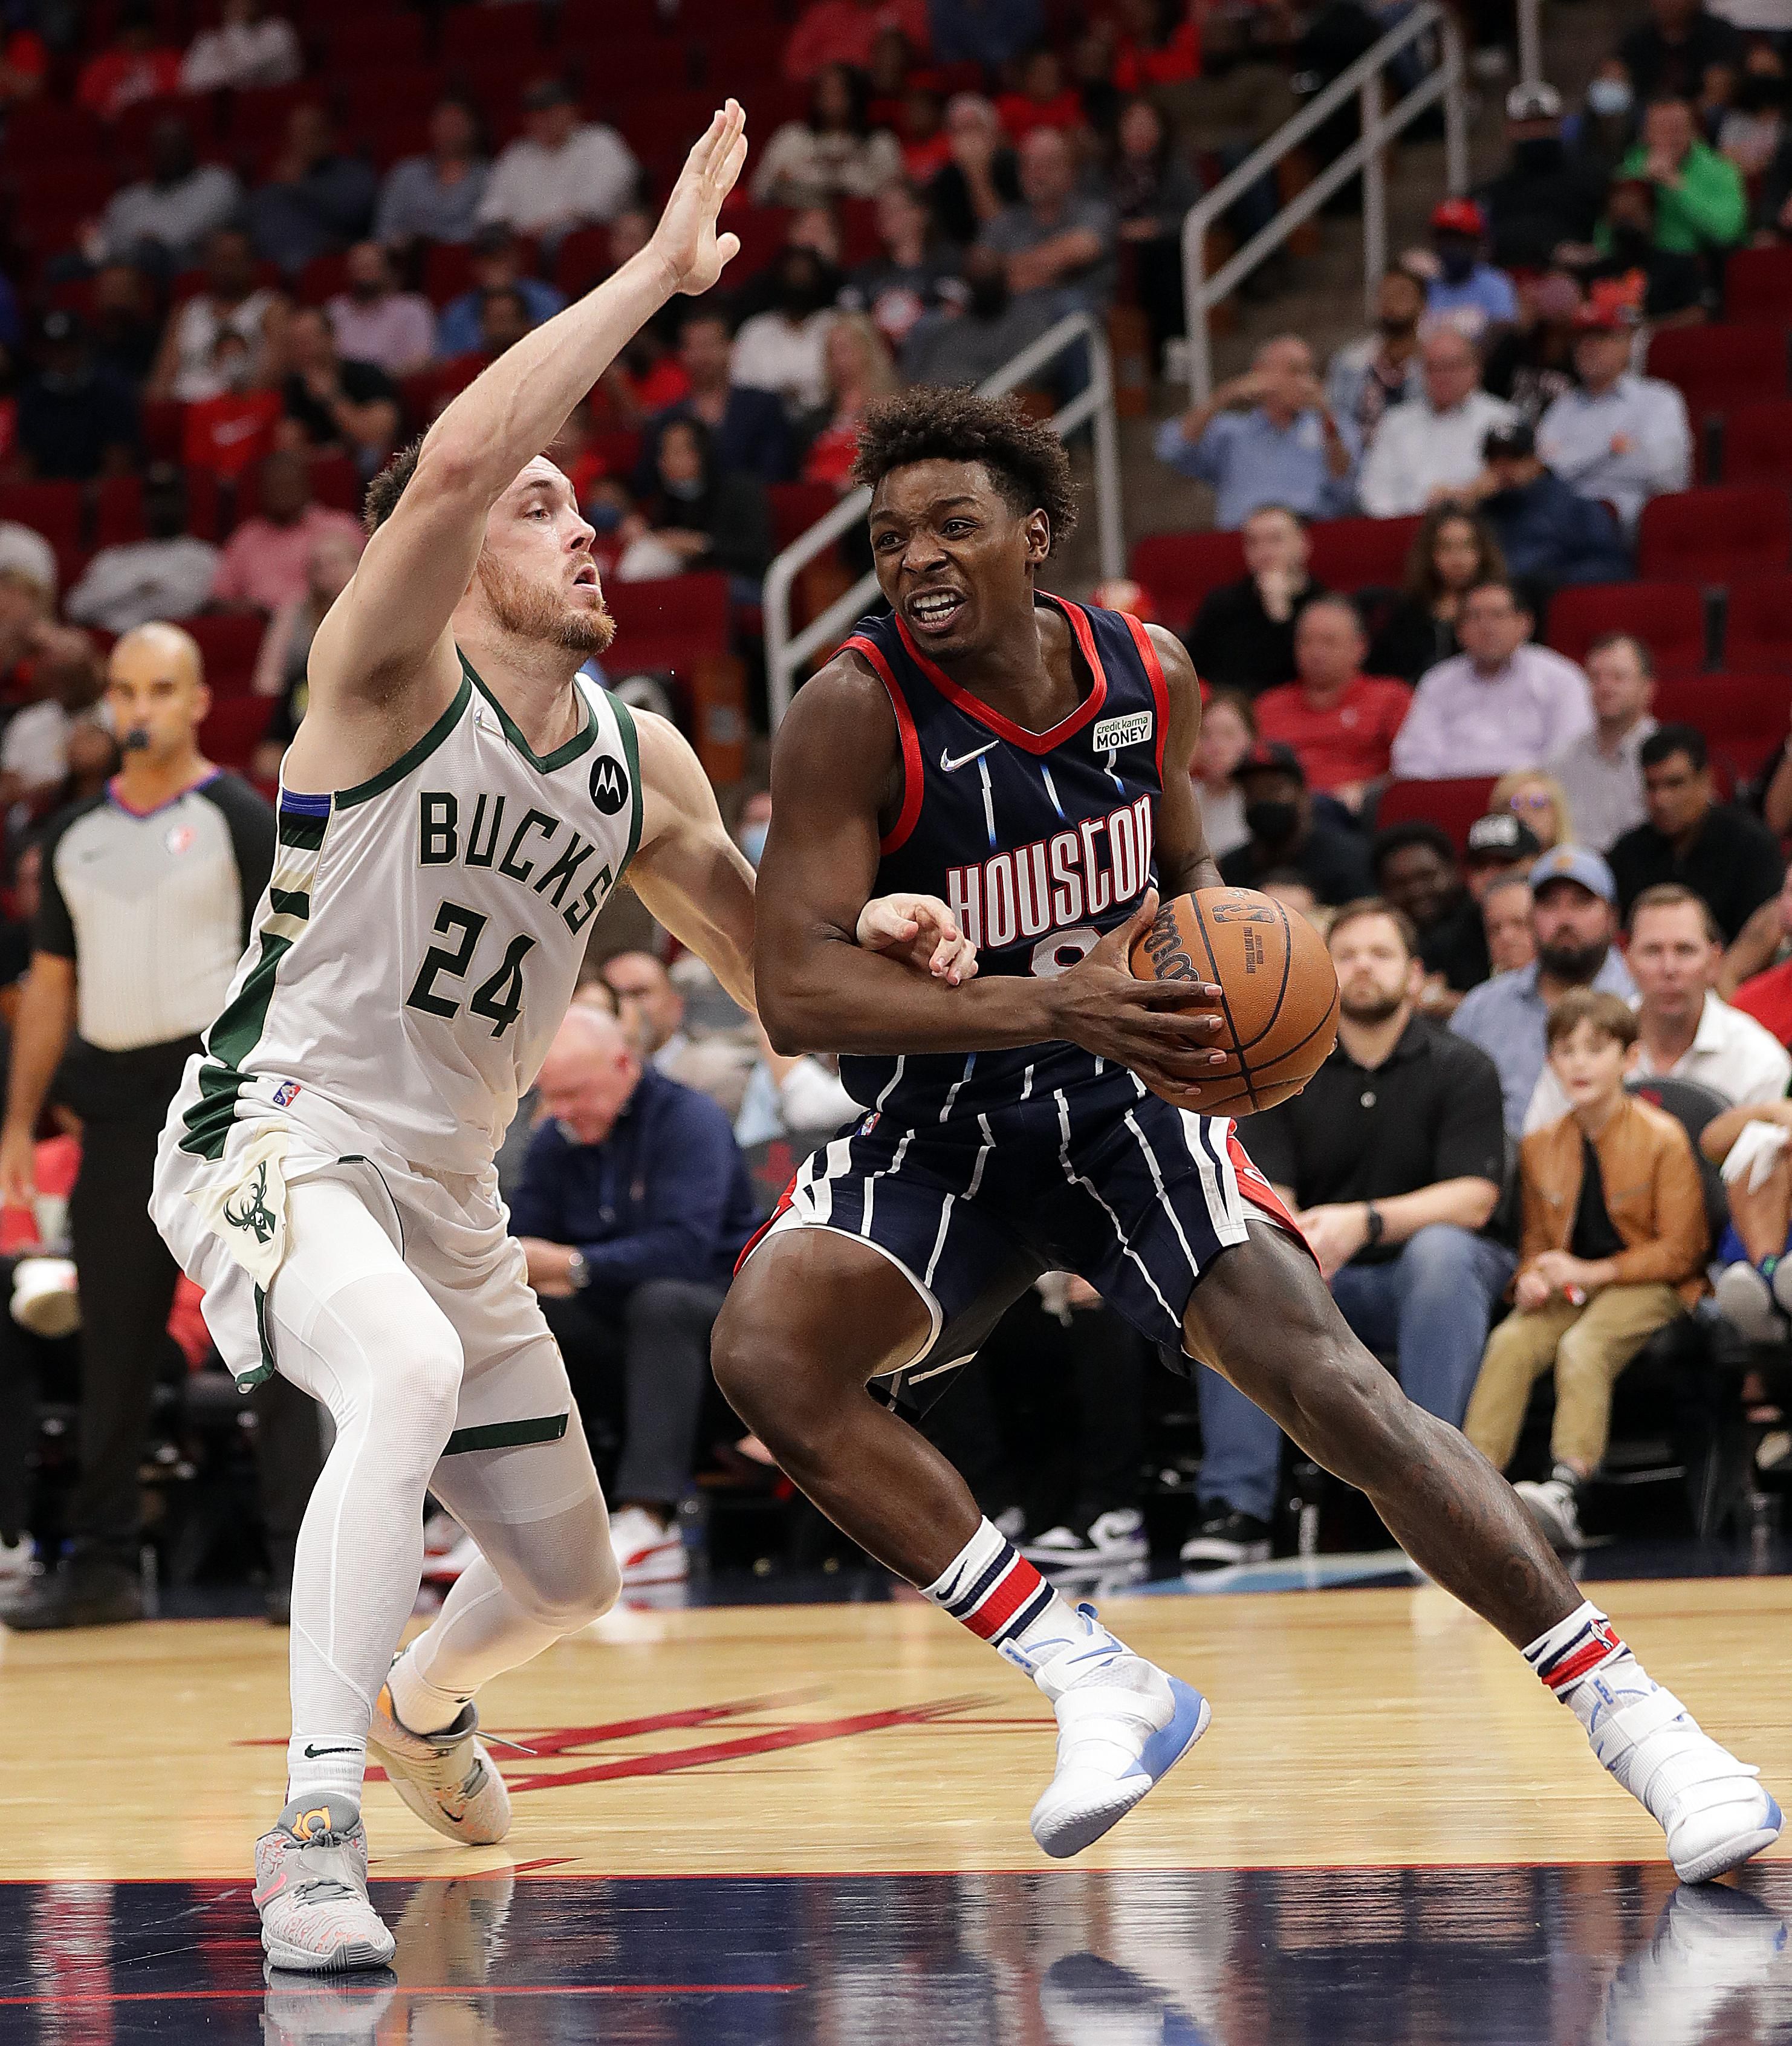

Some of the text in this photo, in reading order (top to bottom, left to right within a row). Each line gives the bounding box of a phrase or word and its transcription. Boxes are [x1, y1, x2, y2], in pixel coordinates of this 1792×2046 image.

[1097, 716, 1148, 734] credit karma
[1097, 725, 1148, 749] MONEY
[418, 790, 615, 940] BUCKS
[404, 898, 540, 1041] 24
